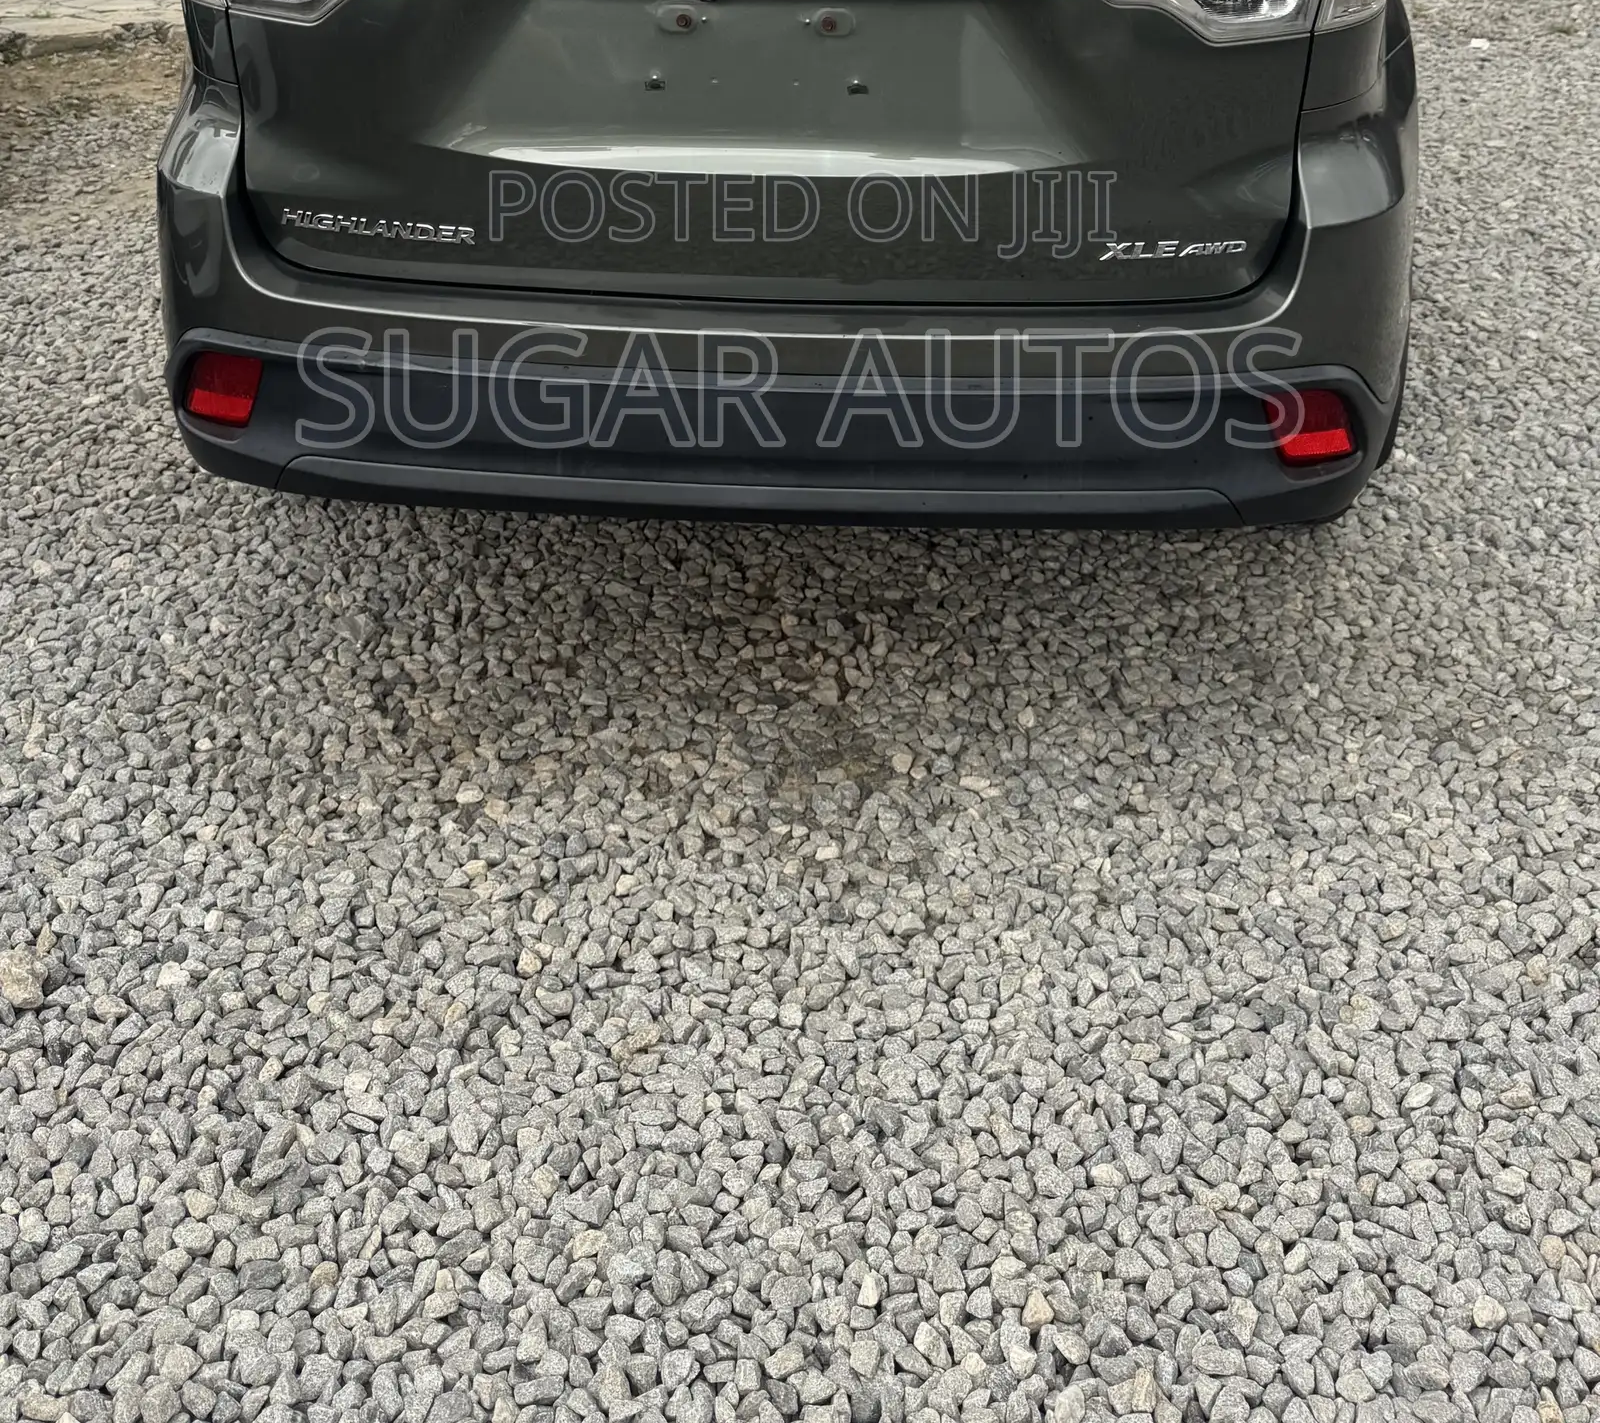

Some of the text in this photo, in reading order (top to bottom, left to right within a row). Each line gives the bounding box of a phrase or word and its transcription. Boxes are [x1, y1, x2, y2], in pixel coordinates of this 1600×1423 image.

[281, 208, 476, 245] HIGHLANDER
[1099, 240, 1248, 261] XLE AWD
